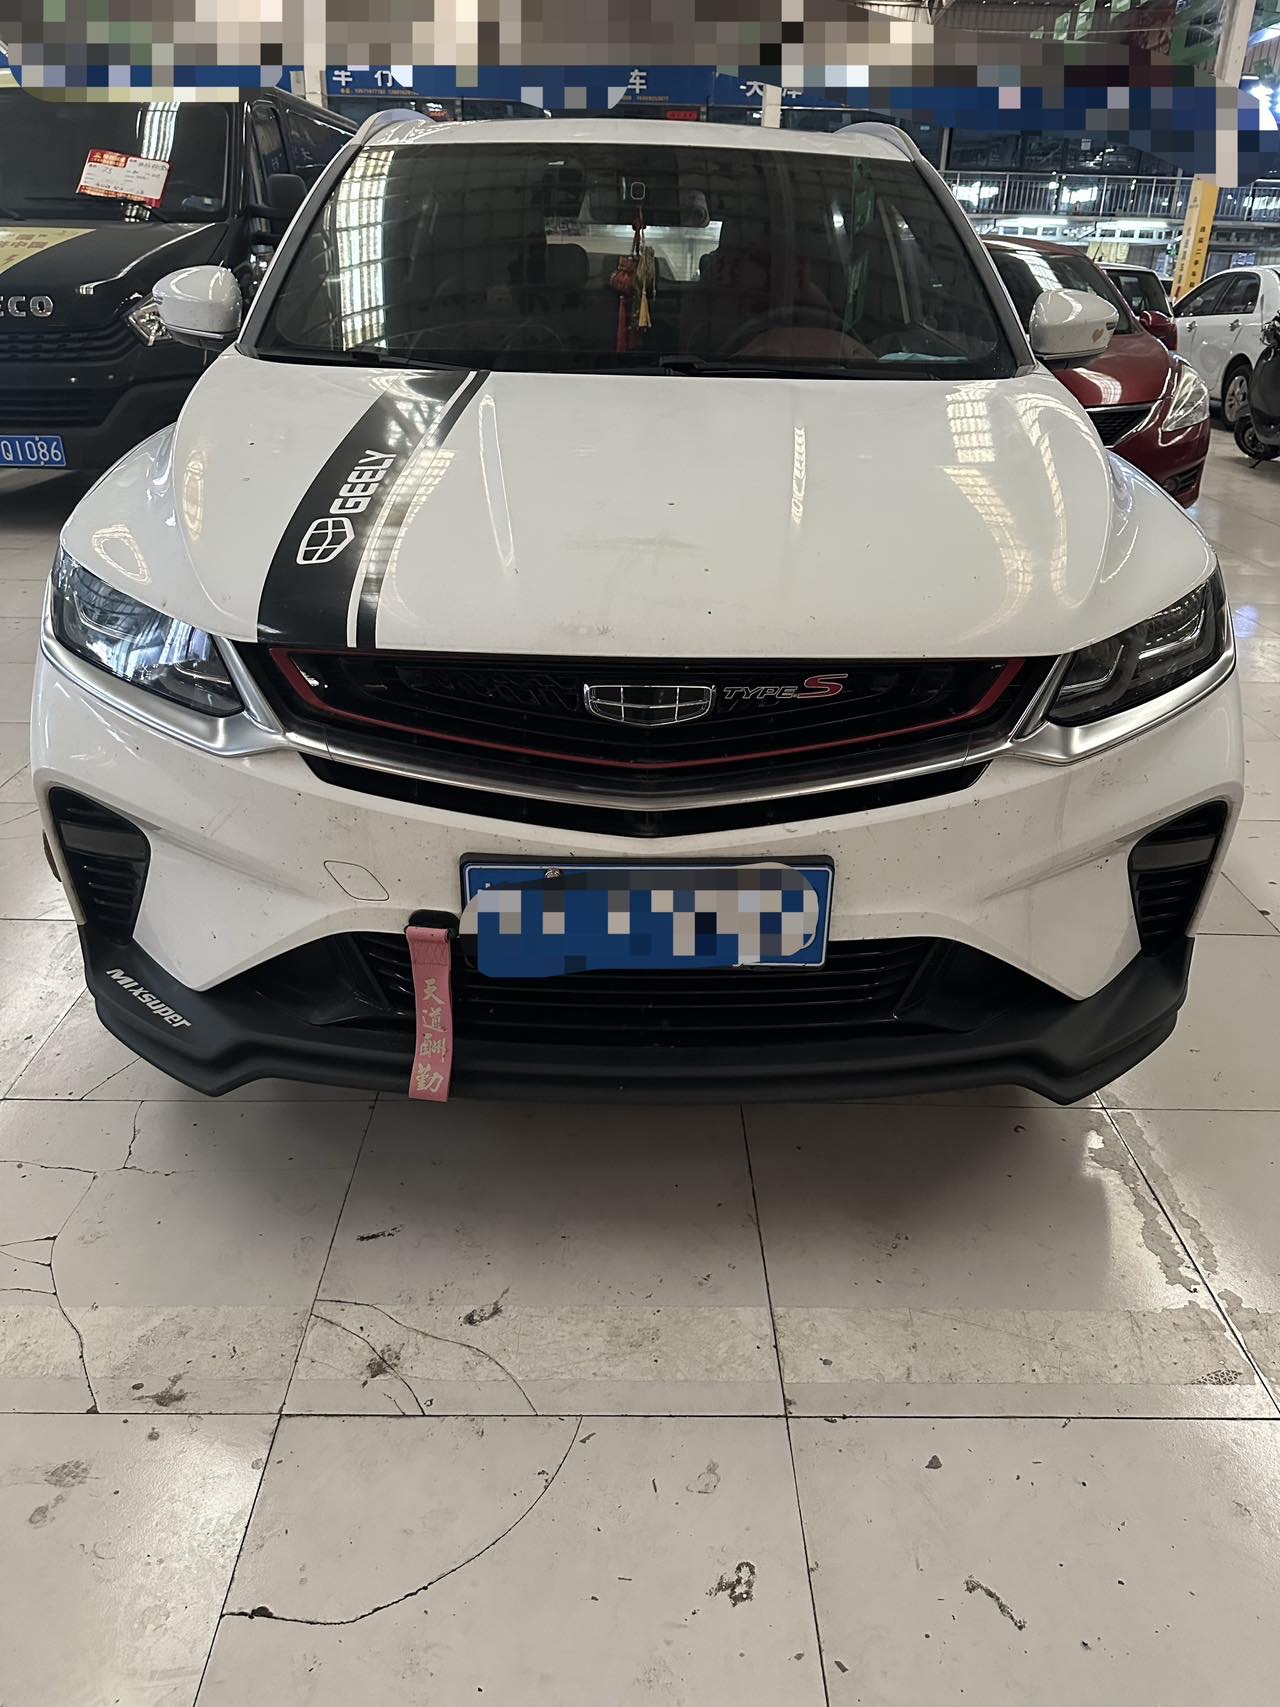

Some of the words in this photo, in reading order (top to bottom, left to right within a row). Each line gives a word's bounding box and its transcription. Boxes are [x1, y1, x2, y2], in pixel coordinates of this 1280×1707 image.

[1, 440, 61, 462] Q1086
[329, 449, 397, 514] GEELY
[723, 686, 798, 700] TYPE
[796, 673, 849, 699] S
[416, 977, 448, 1093] 天道酬勤
